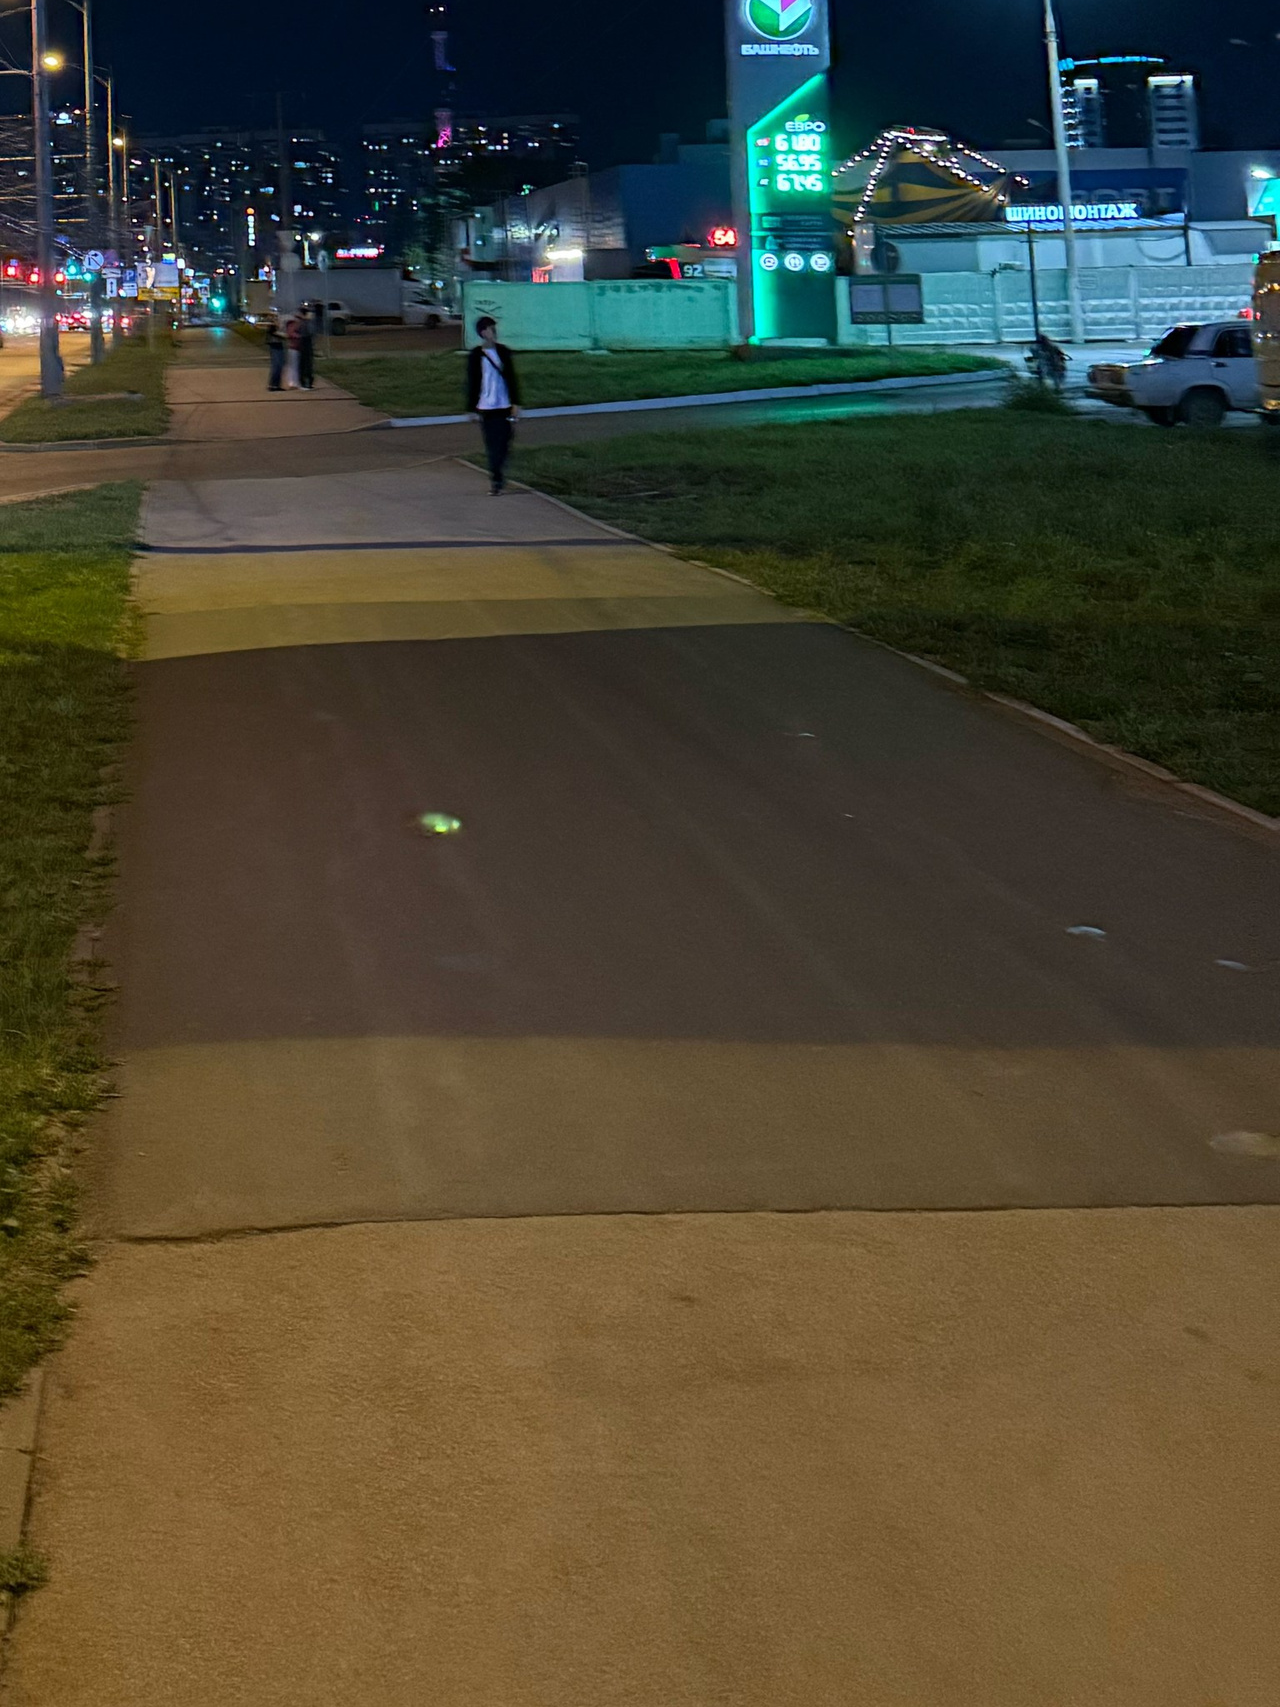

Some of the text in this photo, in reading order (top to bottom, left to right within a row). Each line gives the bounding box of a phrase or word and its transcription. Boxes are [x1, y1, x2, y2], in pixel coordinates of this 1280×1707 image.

[741, 44, 820, 57] БАШНЕФТЬ
[785, 121, 826, 133] ЕВРО
[683, 264, 704, 277] 92
